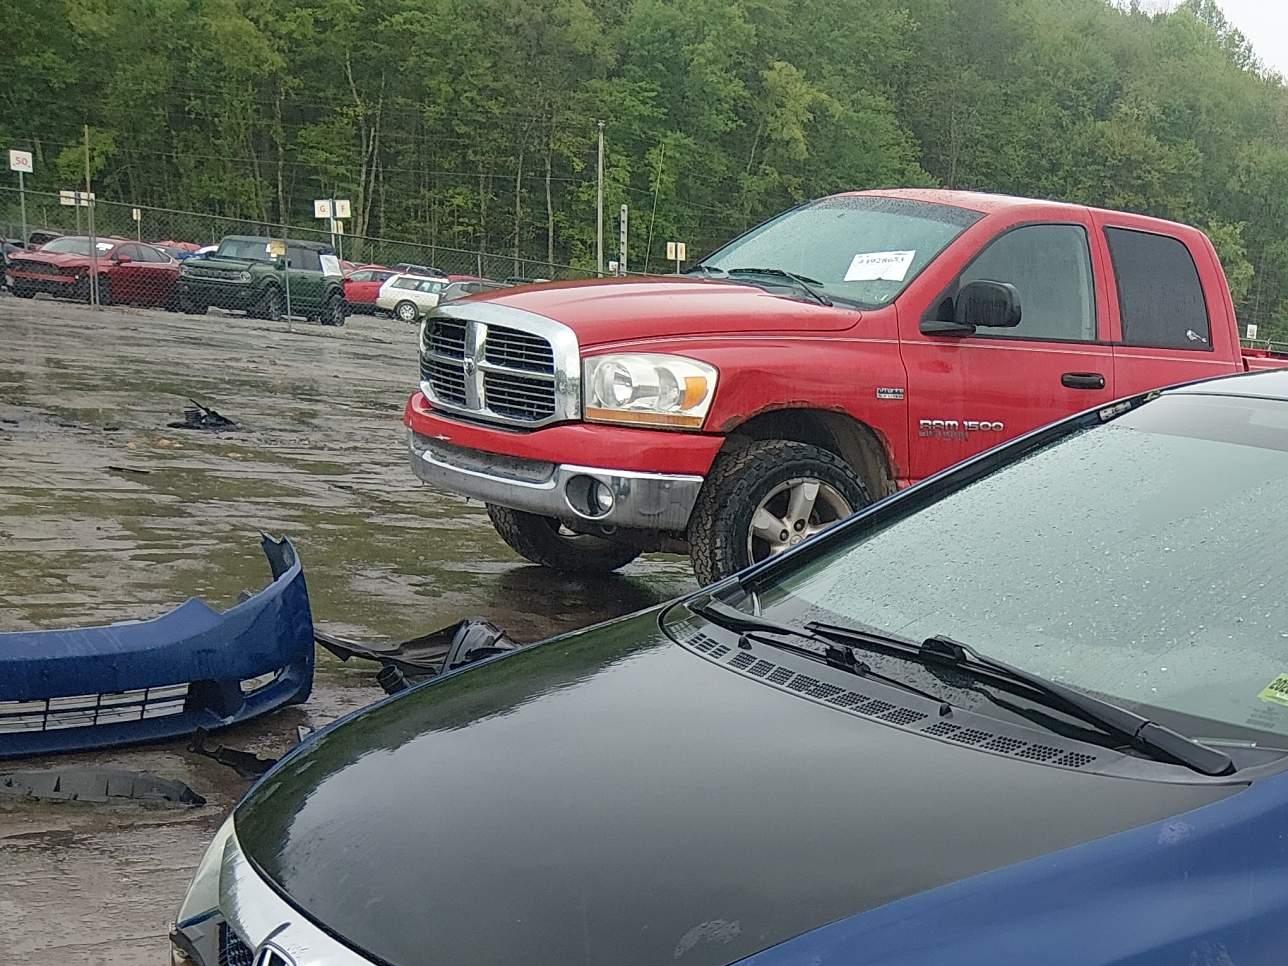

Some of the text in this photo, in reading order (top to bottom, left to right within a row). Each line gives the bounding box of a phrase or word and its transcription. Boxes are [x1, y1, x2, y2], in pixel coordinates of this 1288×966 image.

[15, 156, 28, 166] 50
[319, 205, 326, 213] G
[919, 419, 1004, 431] RAM 1500
